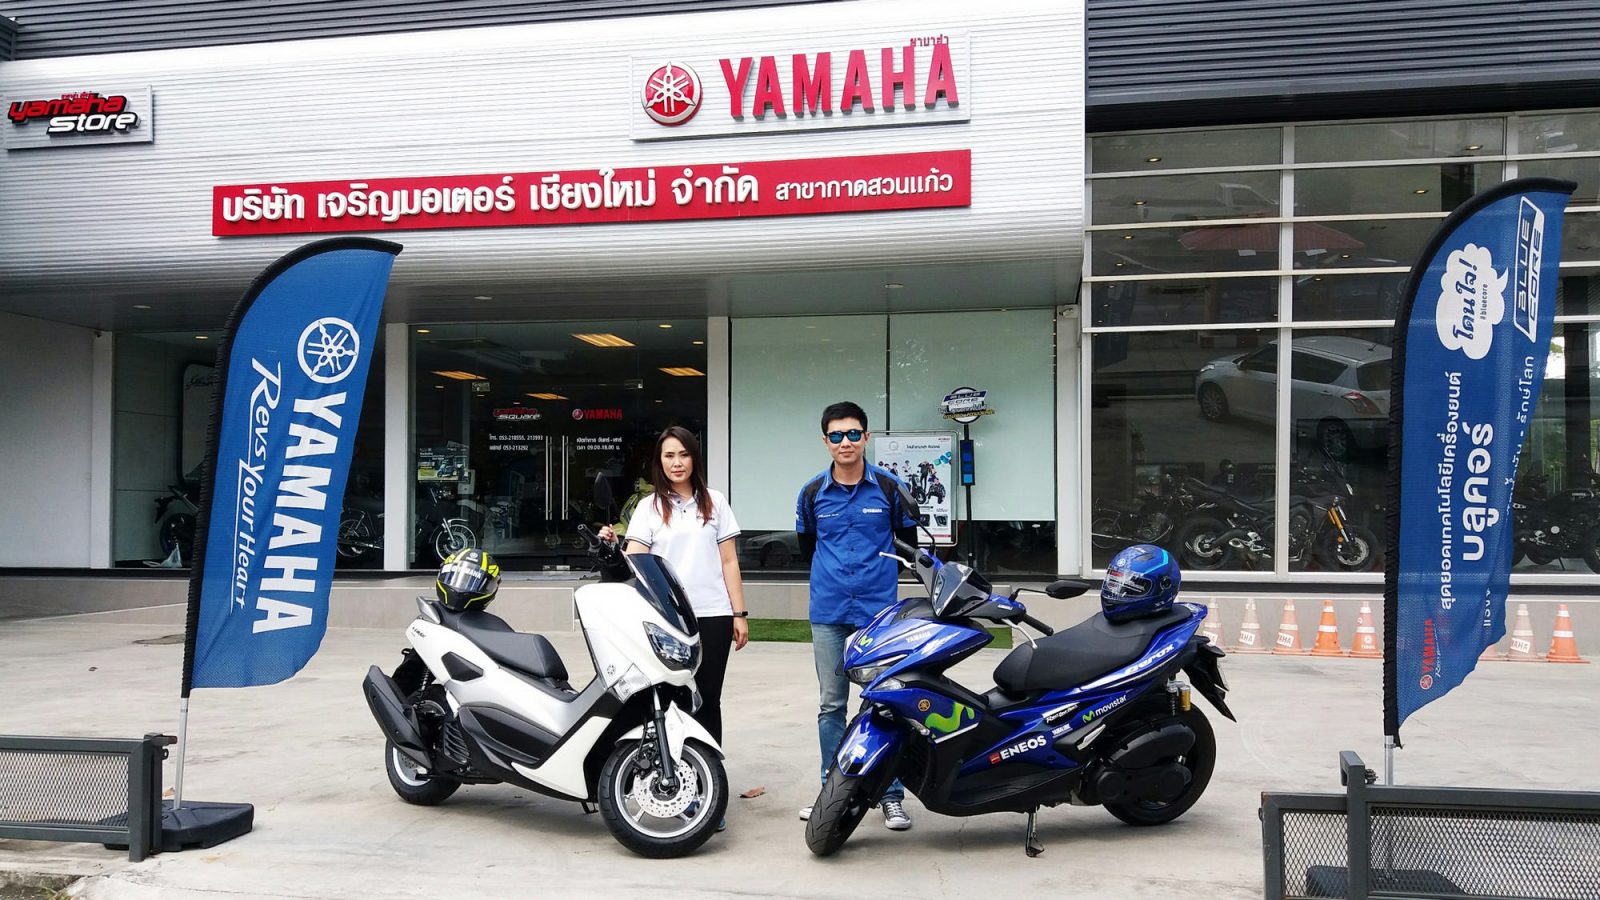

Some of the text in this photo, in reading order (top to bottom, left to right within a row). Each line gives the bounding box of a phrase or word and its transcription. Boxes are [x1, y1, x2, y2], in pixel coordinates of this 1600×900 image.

[719, 44, 958, 119] YAMAHA
[223, 166, 953, 222] บริษัท เจริญมอเตอร์ เชียงใหม่ จำกัด สาขากาดสวนแก้ว
[1452, 258, 1478, 341] โดนใจ!
[1480, 283, 1489, 321] #bluecore
[1517, 217, 1532, 313] BLUE
[1530, 230, 1542, 322] CORE
[584, 409, 623, 419] YAMAHA
[236, 358, 283, 611] Revs Your Heart
[252, 391, 347, 634] YAMAHA
[1437, 371, 1463, 611] สุดยอดเทคโนโลยีเครื่องยนต์
[1462, 422, 1500, 561] บลูคอร์
[905, 631, 932, 643] YAMAHA
[1421, 618, 1435, 675] YAMAHA
[1095, 695, 1127, 716] movistar
[1000, 735, 1048, 760] ENEOS
